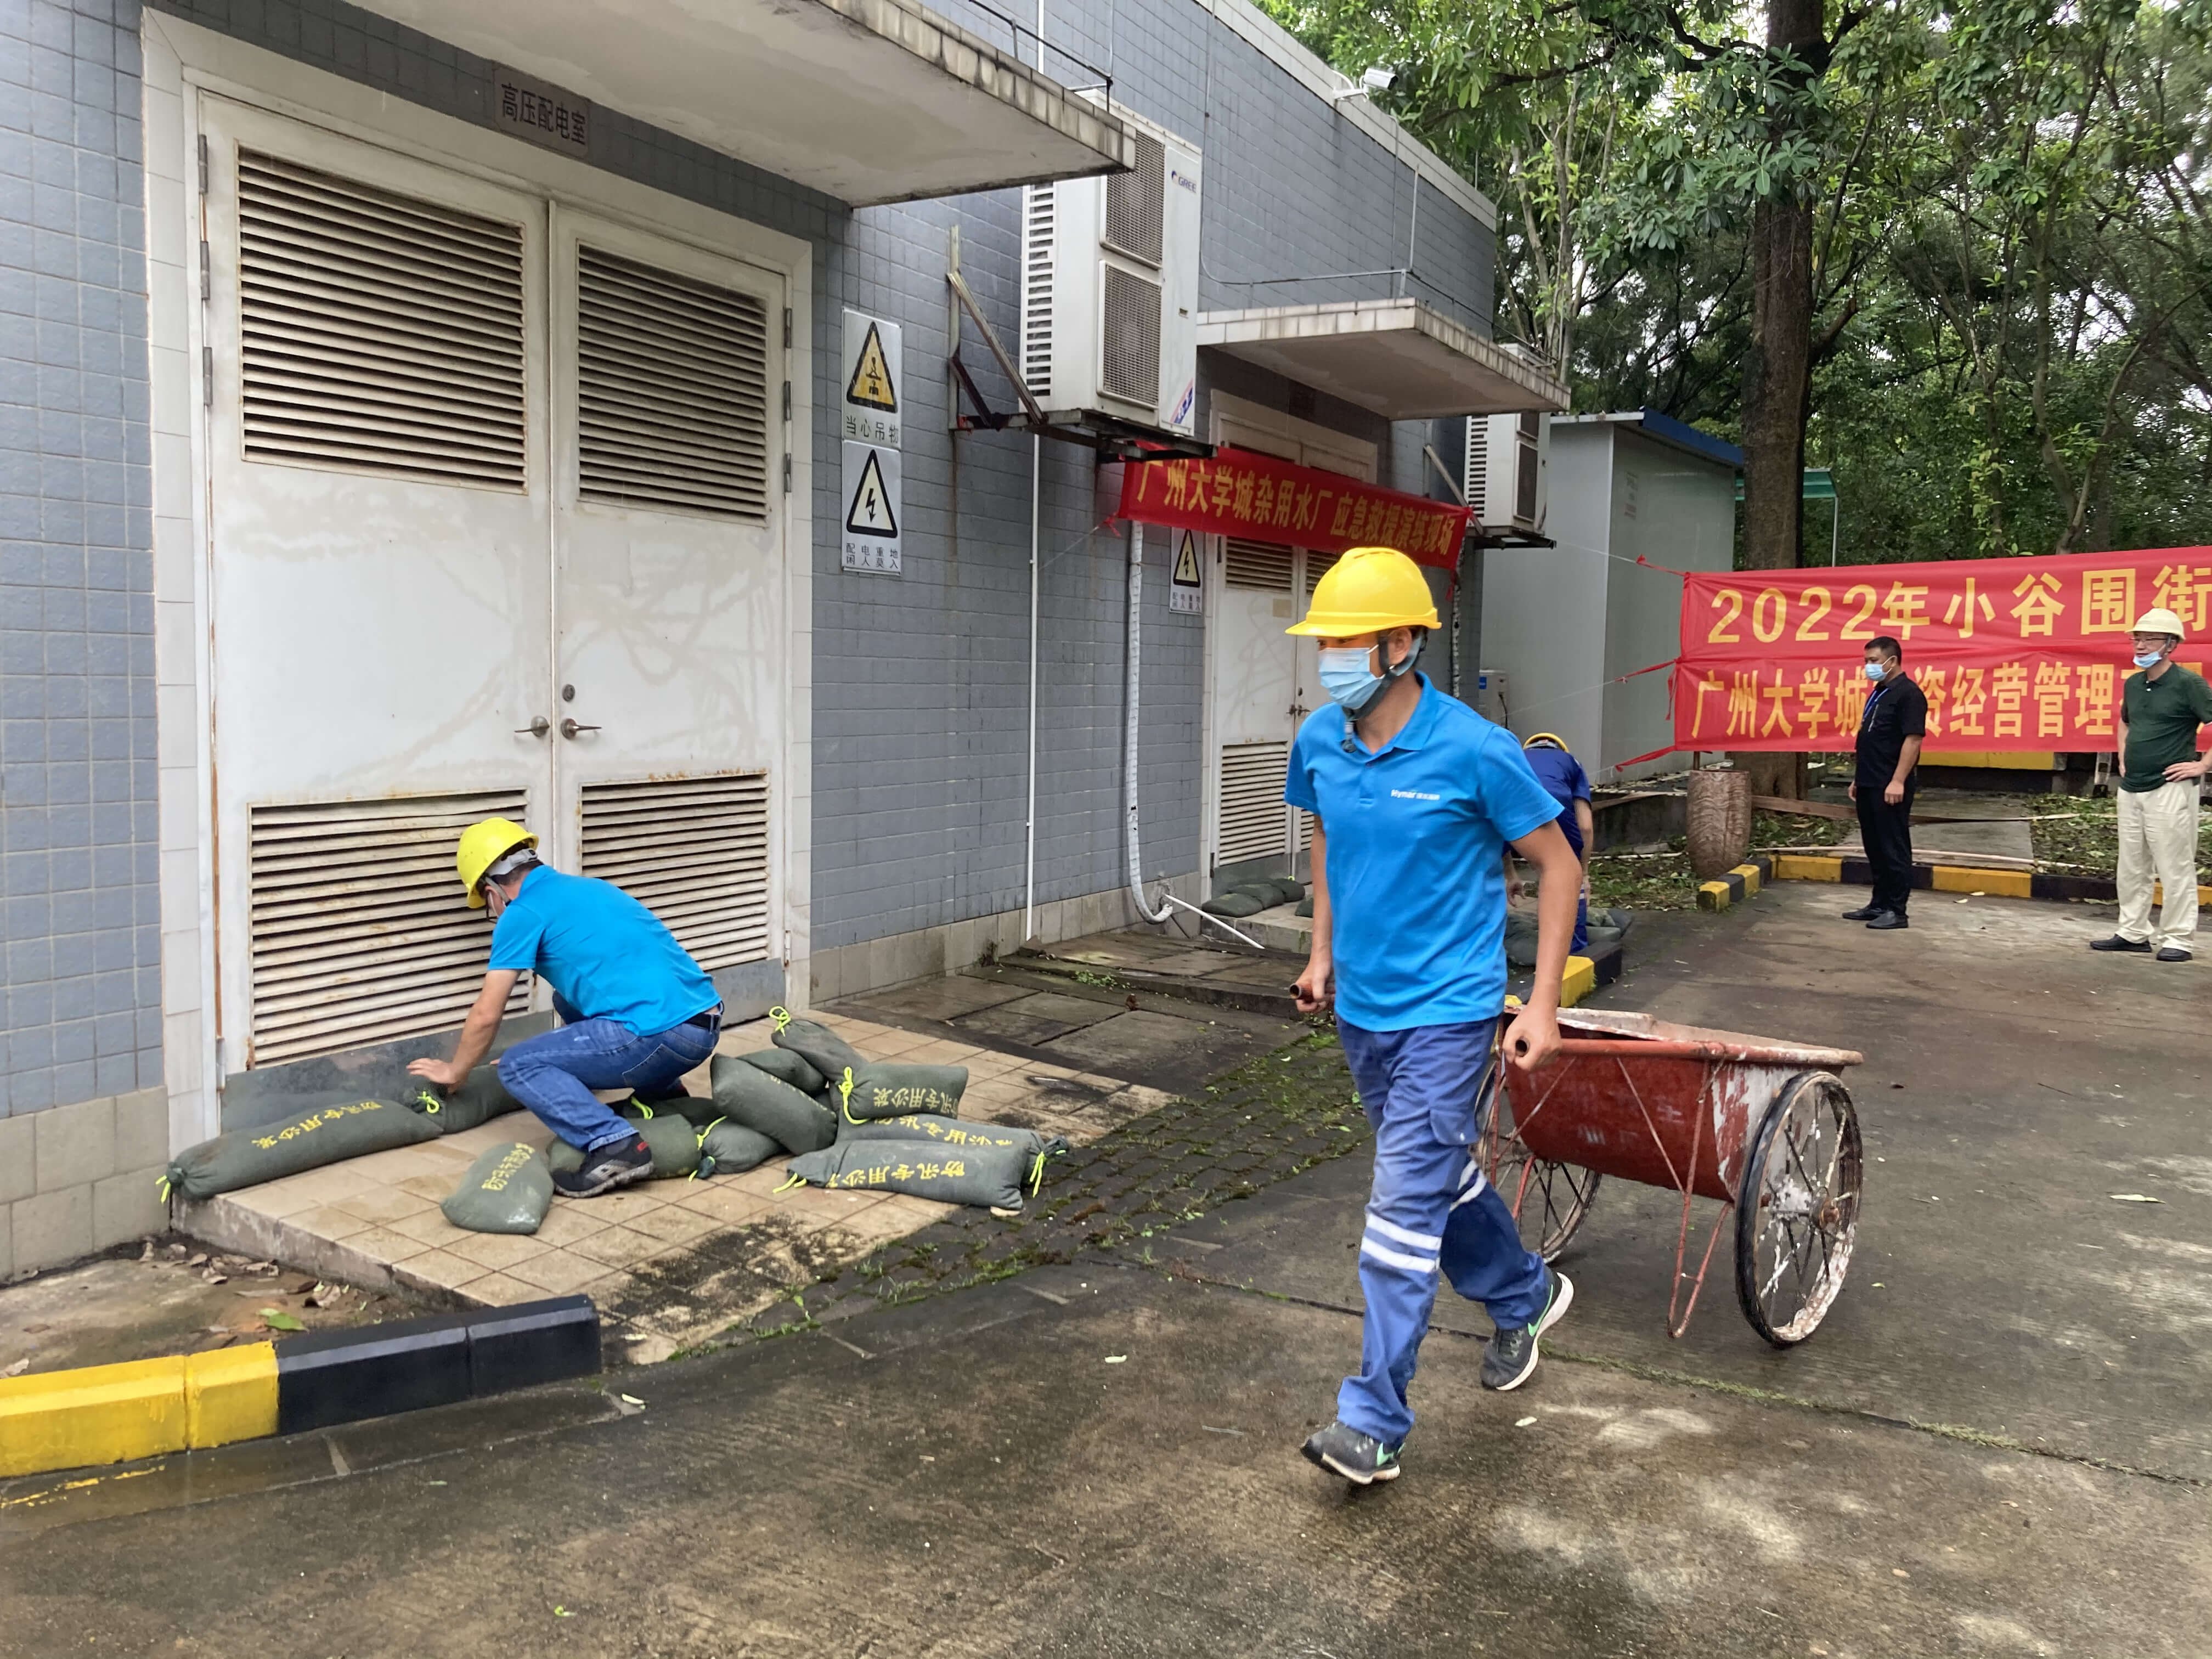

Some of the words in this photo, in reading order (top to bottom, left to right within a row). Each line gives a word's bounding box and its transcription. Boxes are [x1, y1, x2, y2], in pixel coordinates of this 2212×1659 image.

[501, 82, 585, 145] 高压配电室
[1178, 176, 1197, 193] GREE
[847, 415, 899, 443] 当心吊物
[847, 543, 898, 558] 配电重地
[847, 554, 898, 569] 闲人莫入
[1707, 564, 2212, 644] 2022年小谷围街
[1692, 661, 2202, 739] 广州大学城资经营管理
